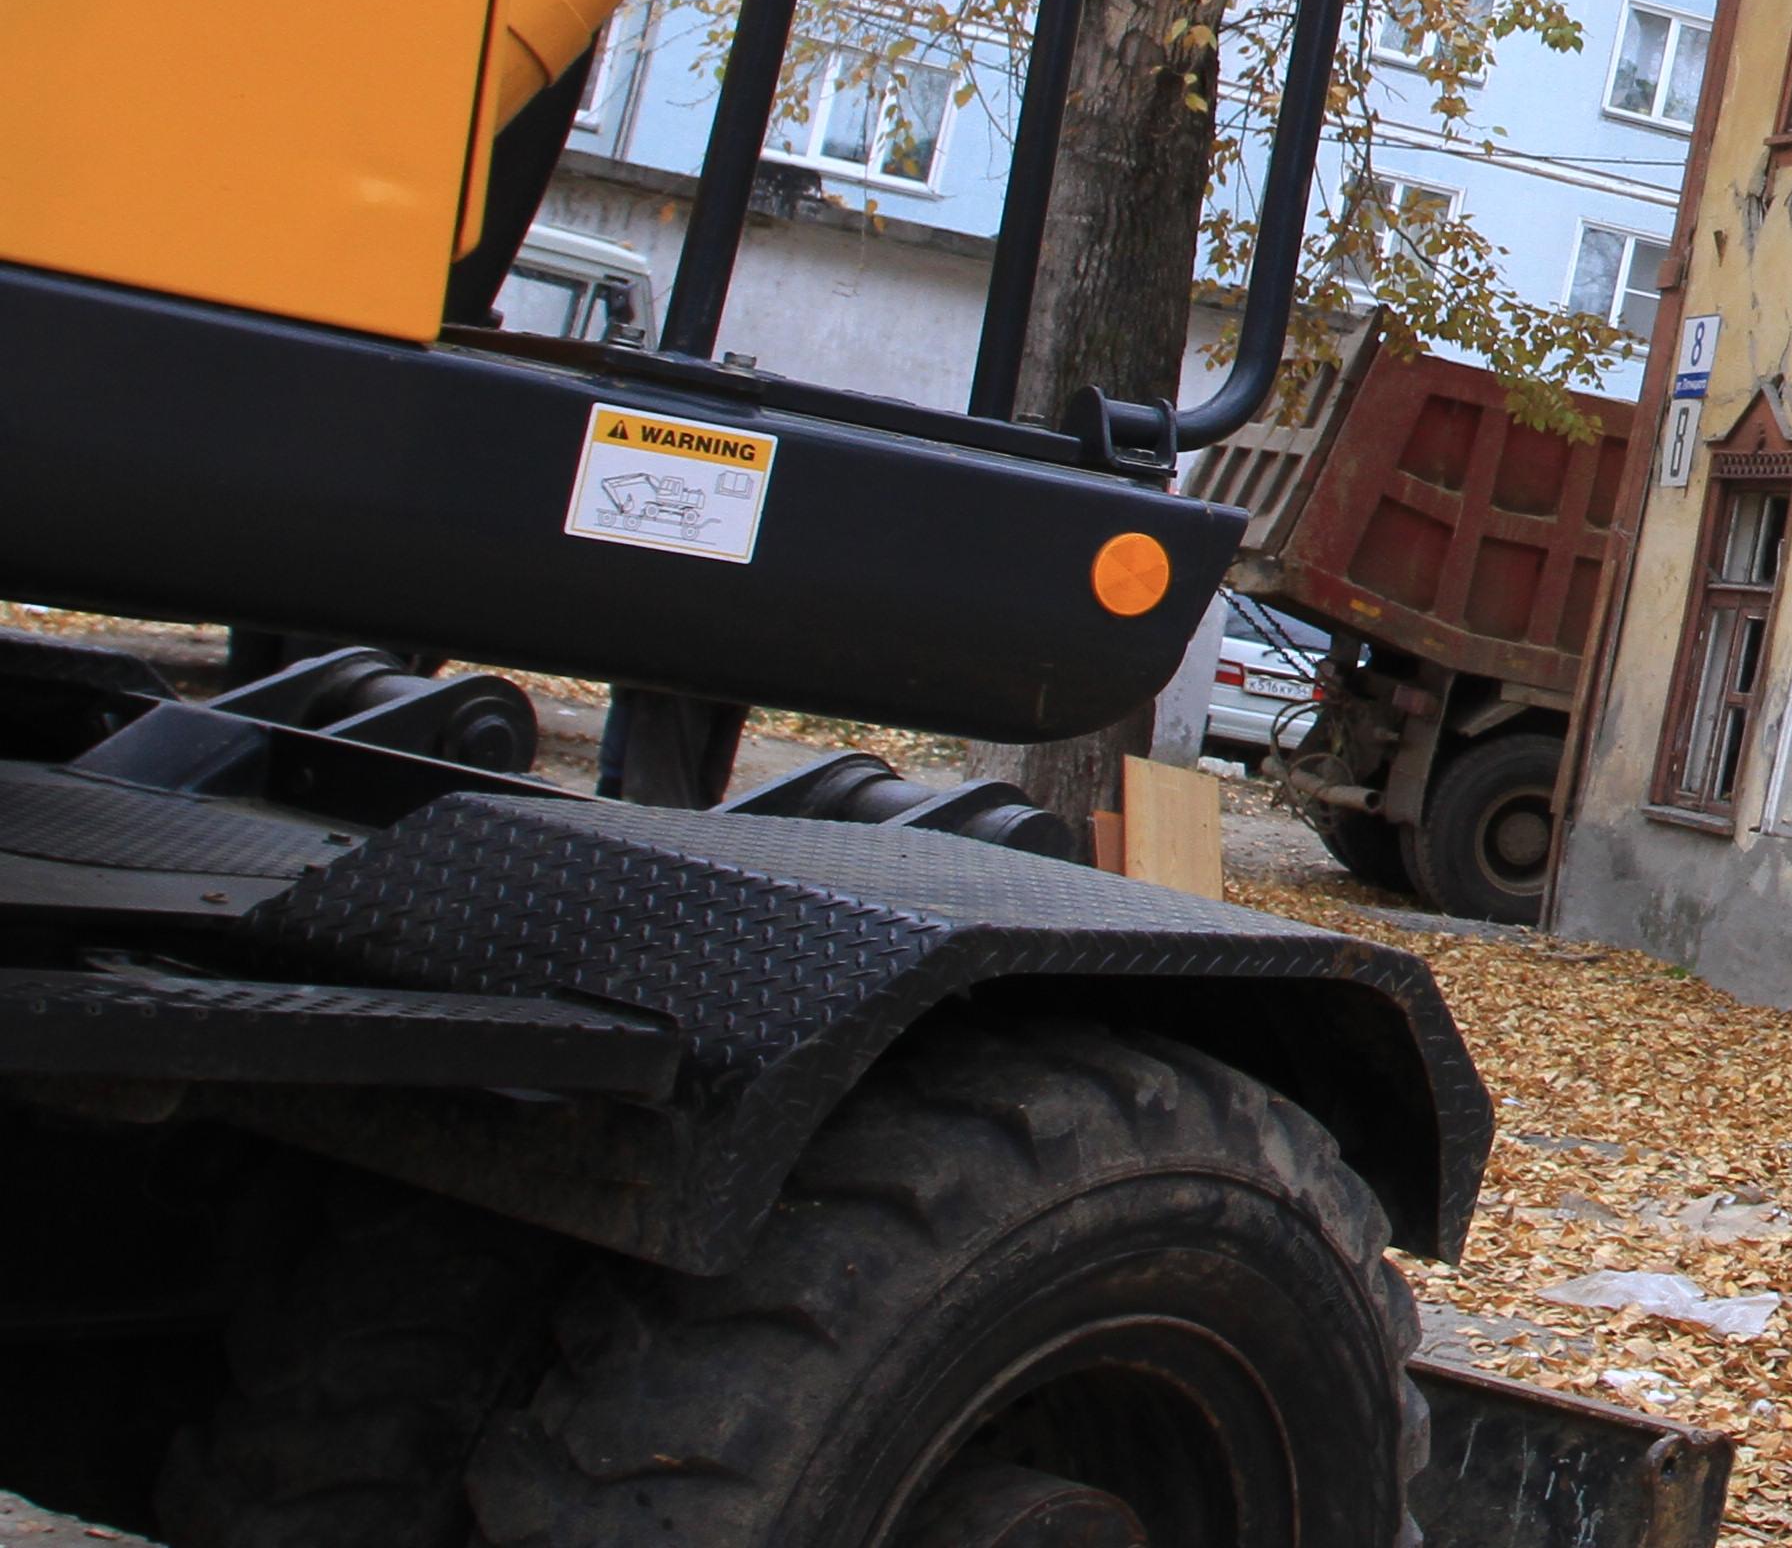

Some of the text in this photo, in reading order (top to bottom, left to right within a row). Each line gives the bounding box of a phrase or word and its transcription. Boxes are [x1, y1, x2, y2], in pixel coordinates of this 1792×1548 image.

[1691, 321, 1705, 367] 8
[641, 425, 757, 462] WARNING
[1670, 407, 1689, 477] 8
